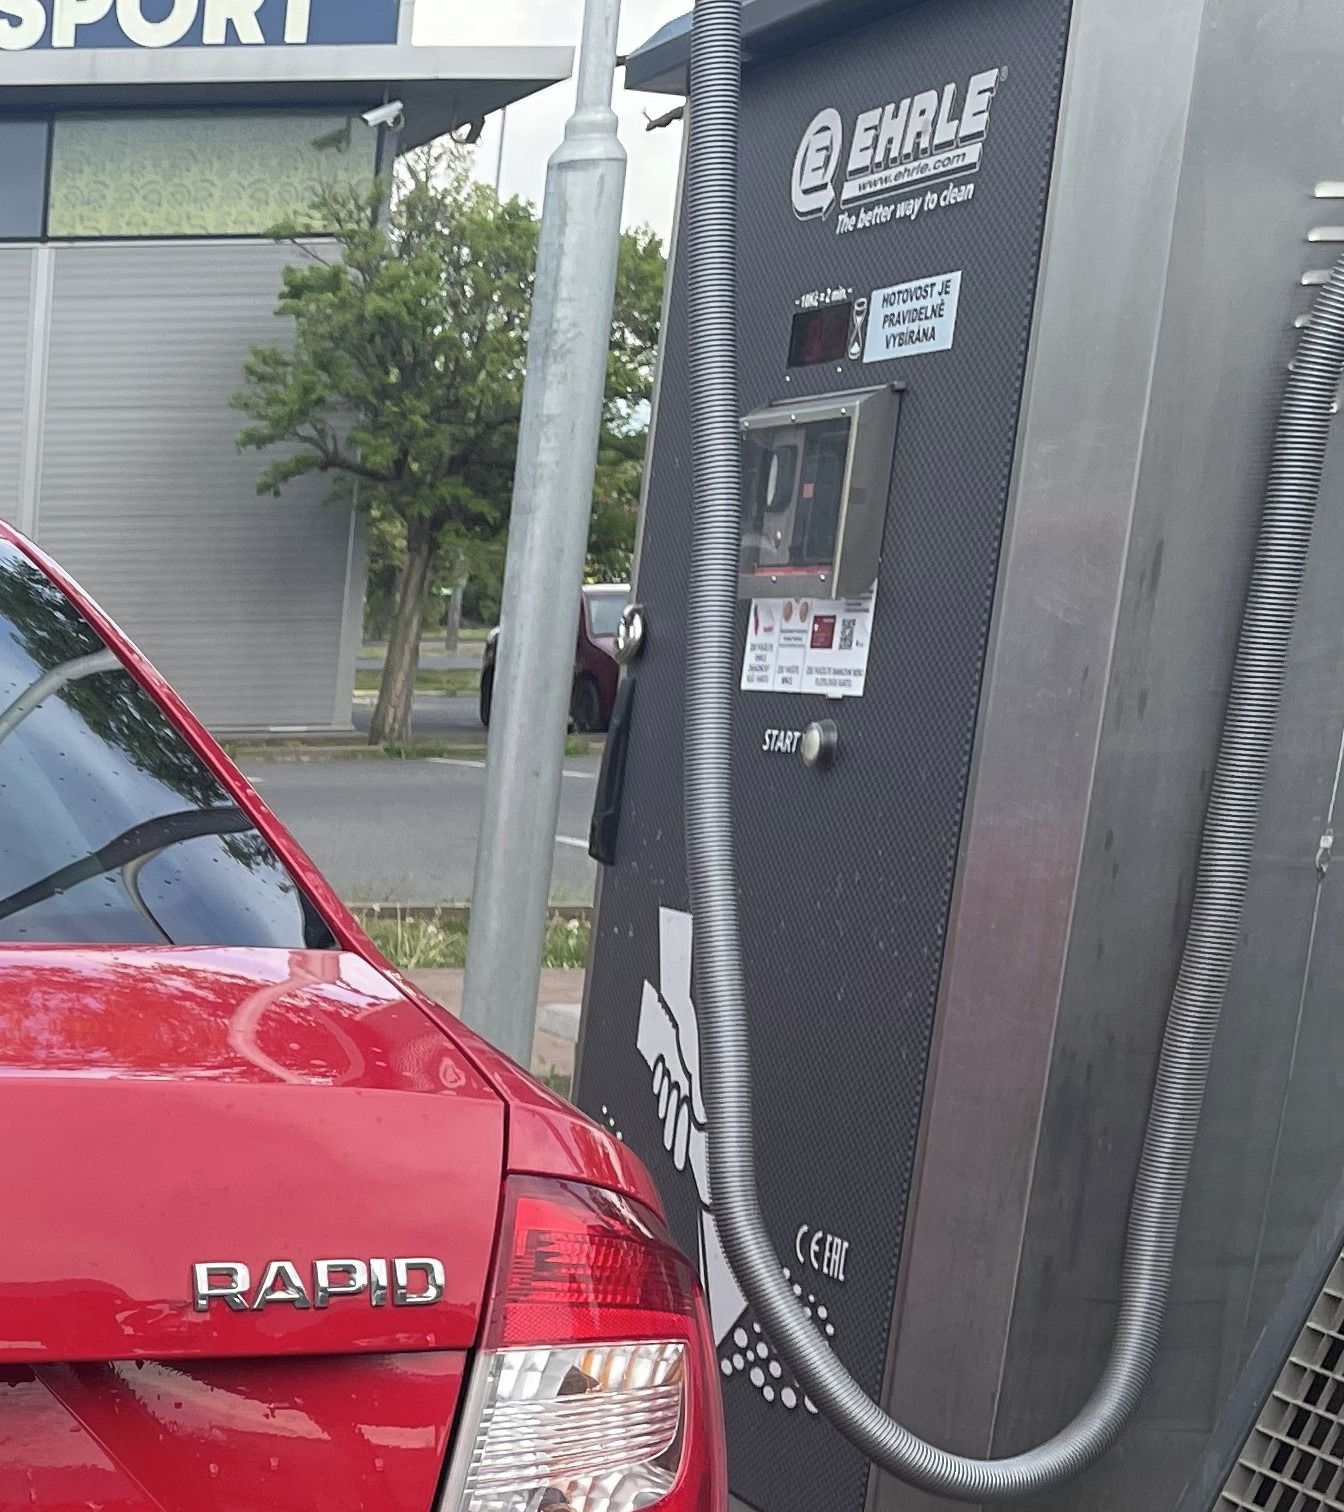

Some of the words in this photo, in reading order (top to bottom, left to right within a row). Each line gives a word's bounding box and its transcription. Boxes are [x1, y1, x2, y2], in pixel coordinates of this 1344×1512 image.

[846, 66, 1001, 181] EHRLE
[858, 151, 966, 193] www.ehrle.com
[836, 212, 856, 235] The
[857, 204, 895, 230] better
[896, 197, 924, 221] way
[923, 190, 939, 212] to
[940, 182, 975, 207] clean
[882, 282, 937, 309] HOTOVOST
[937, 279, 952, 296] JE
[882, 298, 946, 329] PRAVIDELNĚ
[885, 326, 936, 350] VYBÍRÁNA
[762, 729, 800, 754] START
[192, 1257, 447, 1312] RAPID
